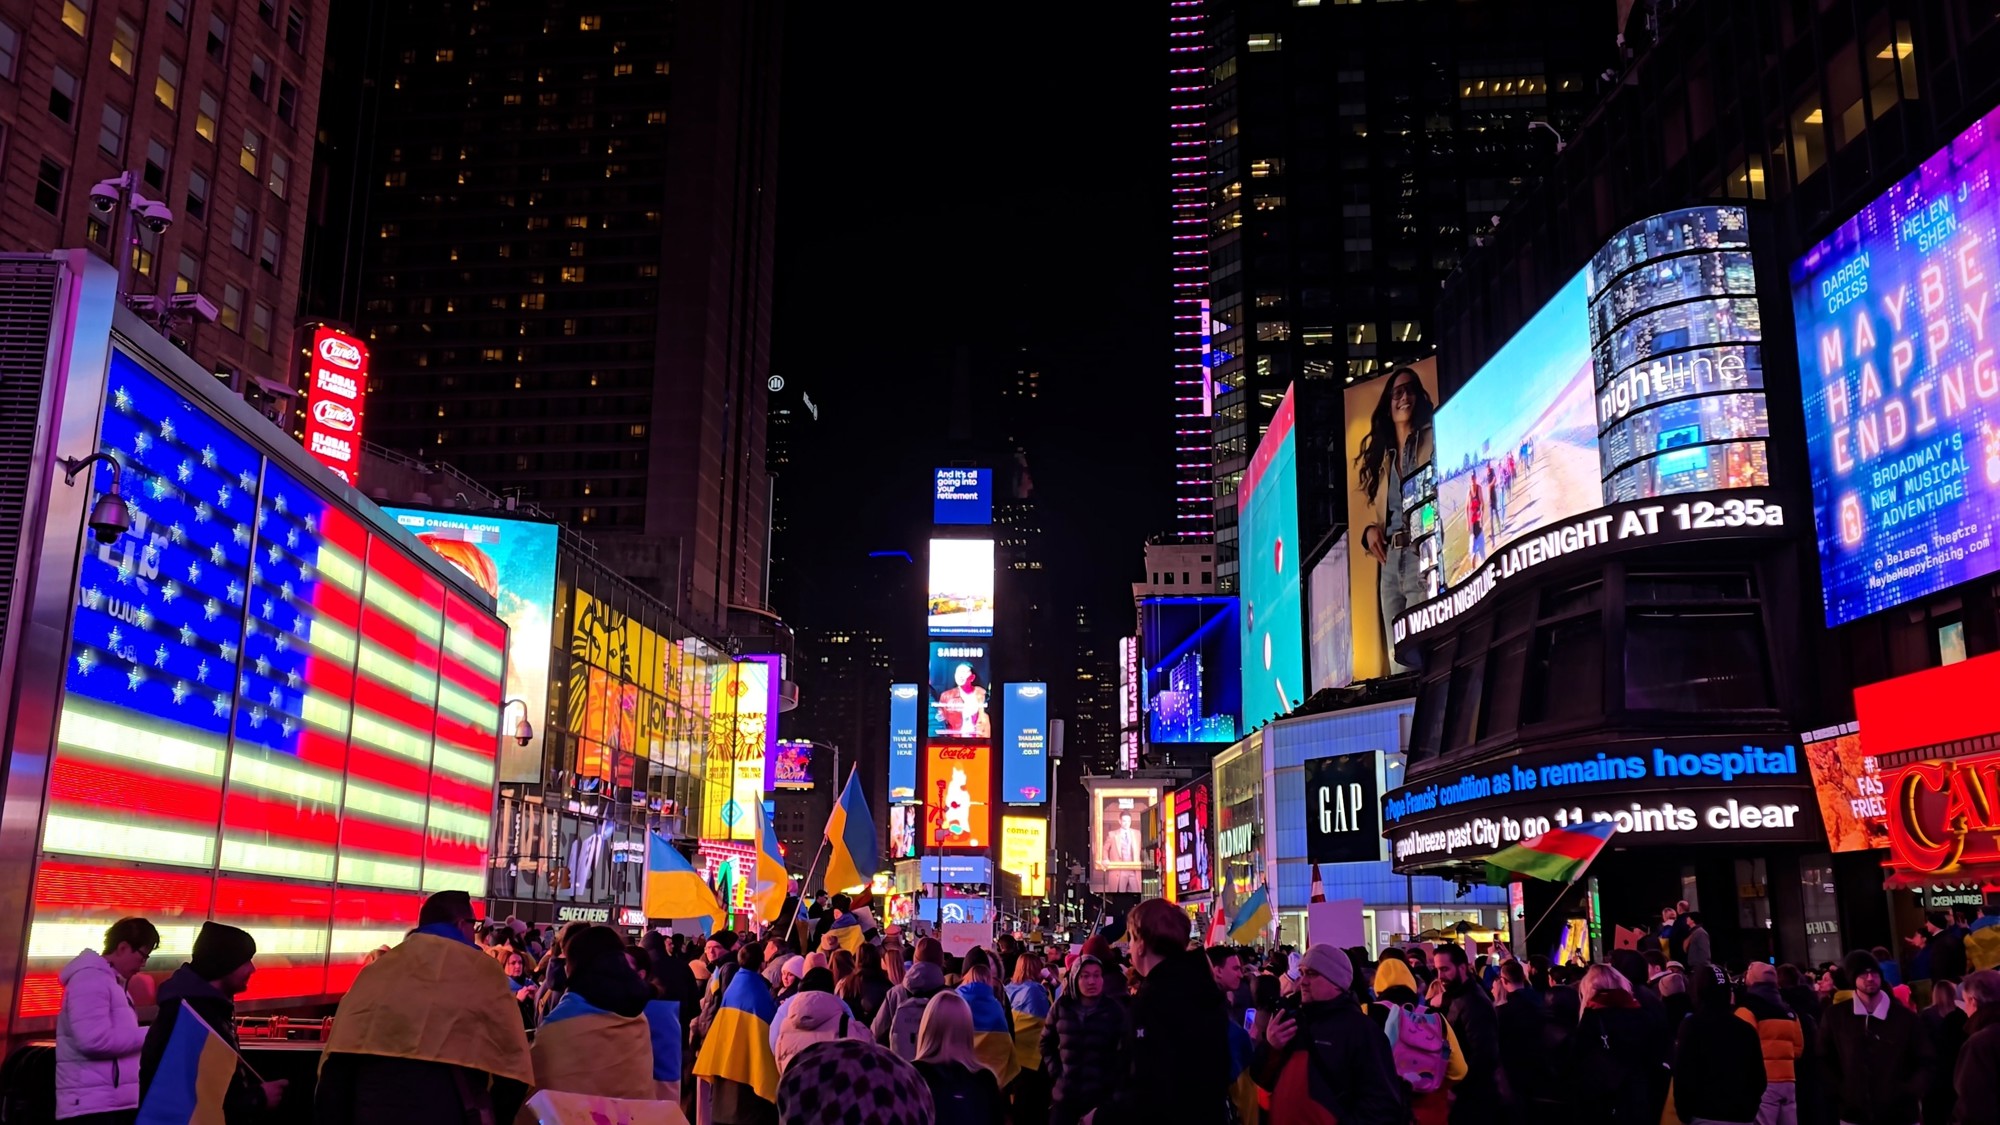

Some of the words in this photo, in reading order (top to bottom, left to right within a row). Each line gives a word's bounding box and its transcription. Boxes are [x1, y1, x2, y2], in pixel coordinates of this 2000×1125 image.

[1902, 195, 1949, 242] HELEN
[1958, 181, 1968, 203] J
[1918, 213, 1957, 253] SHEN
[1822, 252, 1870, 298] DARREN
[1828, 275, 1869, 314] CRISS
[1821, 237, 1984, 375] MAYBE
[1826, 291, 1989, 424] HAPPY
[1601, 352, 1746, 423] nightline
[1832, 349, 1999, 473] ENDING
[937, 470, 953, 479] And
[954, 470, 966, 479] it's
[967, 470, 978, 479] all
[937, 478, 961, 488] going
[961, 478, 977, 486] into
[1870, 485, 1897, 511] NEW
[1904, 451, 1970, 496] MUSICAL
[1872, 432, 1963, 489] BROADWAY'S
[937, 485, 955, 494] your
[937, 492, 978, 500] retirement
[1882, 479, 1964, 530] ADVENTURE
[426, 518, 469, 530] ORIGINAL
[471, 523, 500, 533] MOVIE
[1886, 543, 1928, 566] Belasco
[1933, 523, 1978, 549] Theatre
[1408, 597, 1453, 635] WATCH
[1454, 563, 1497, 619] NIGHTLINE
[1502, 514, 1614, 580] LATENIGHT
[1619, 506, 1664, 540] AT
[1671, 499, 1784, 531] 12:35a
[1868, 538, 1991, 590] MaybeHappyEnding.com
[937, 647, 984, 658] SAMSUNG
[1318, 782, 1363, 835] GAP
[1388, 798, 1406, 822] Pope
[1404, 784, 1438, 817] Francis'
[1440, 774, 1491, 806] condition
[1491, 773, 1512, 795] as
[1512, 764, 1537, 791] he
[1540, 752, 1647, 788] remains
[1652, 745, 1798, 781] hospital
[1220, 830, 1233, 860] OLD
[1232, 822, 1252, 857] NAVY
[1415, 830, 1447, 854] breeze
[1446, 822, 1472, 854] past
[1471, 817, 1501, 849] City
[1501, 815, 1521, 841] to
[1522, 816, 1550, 841] go
[1554, 806, 1583, 829] 11
[1706, 799, 1800, 830] clear
[558, 906, 609, 923] SKECHERS
